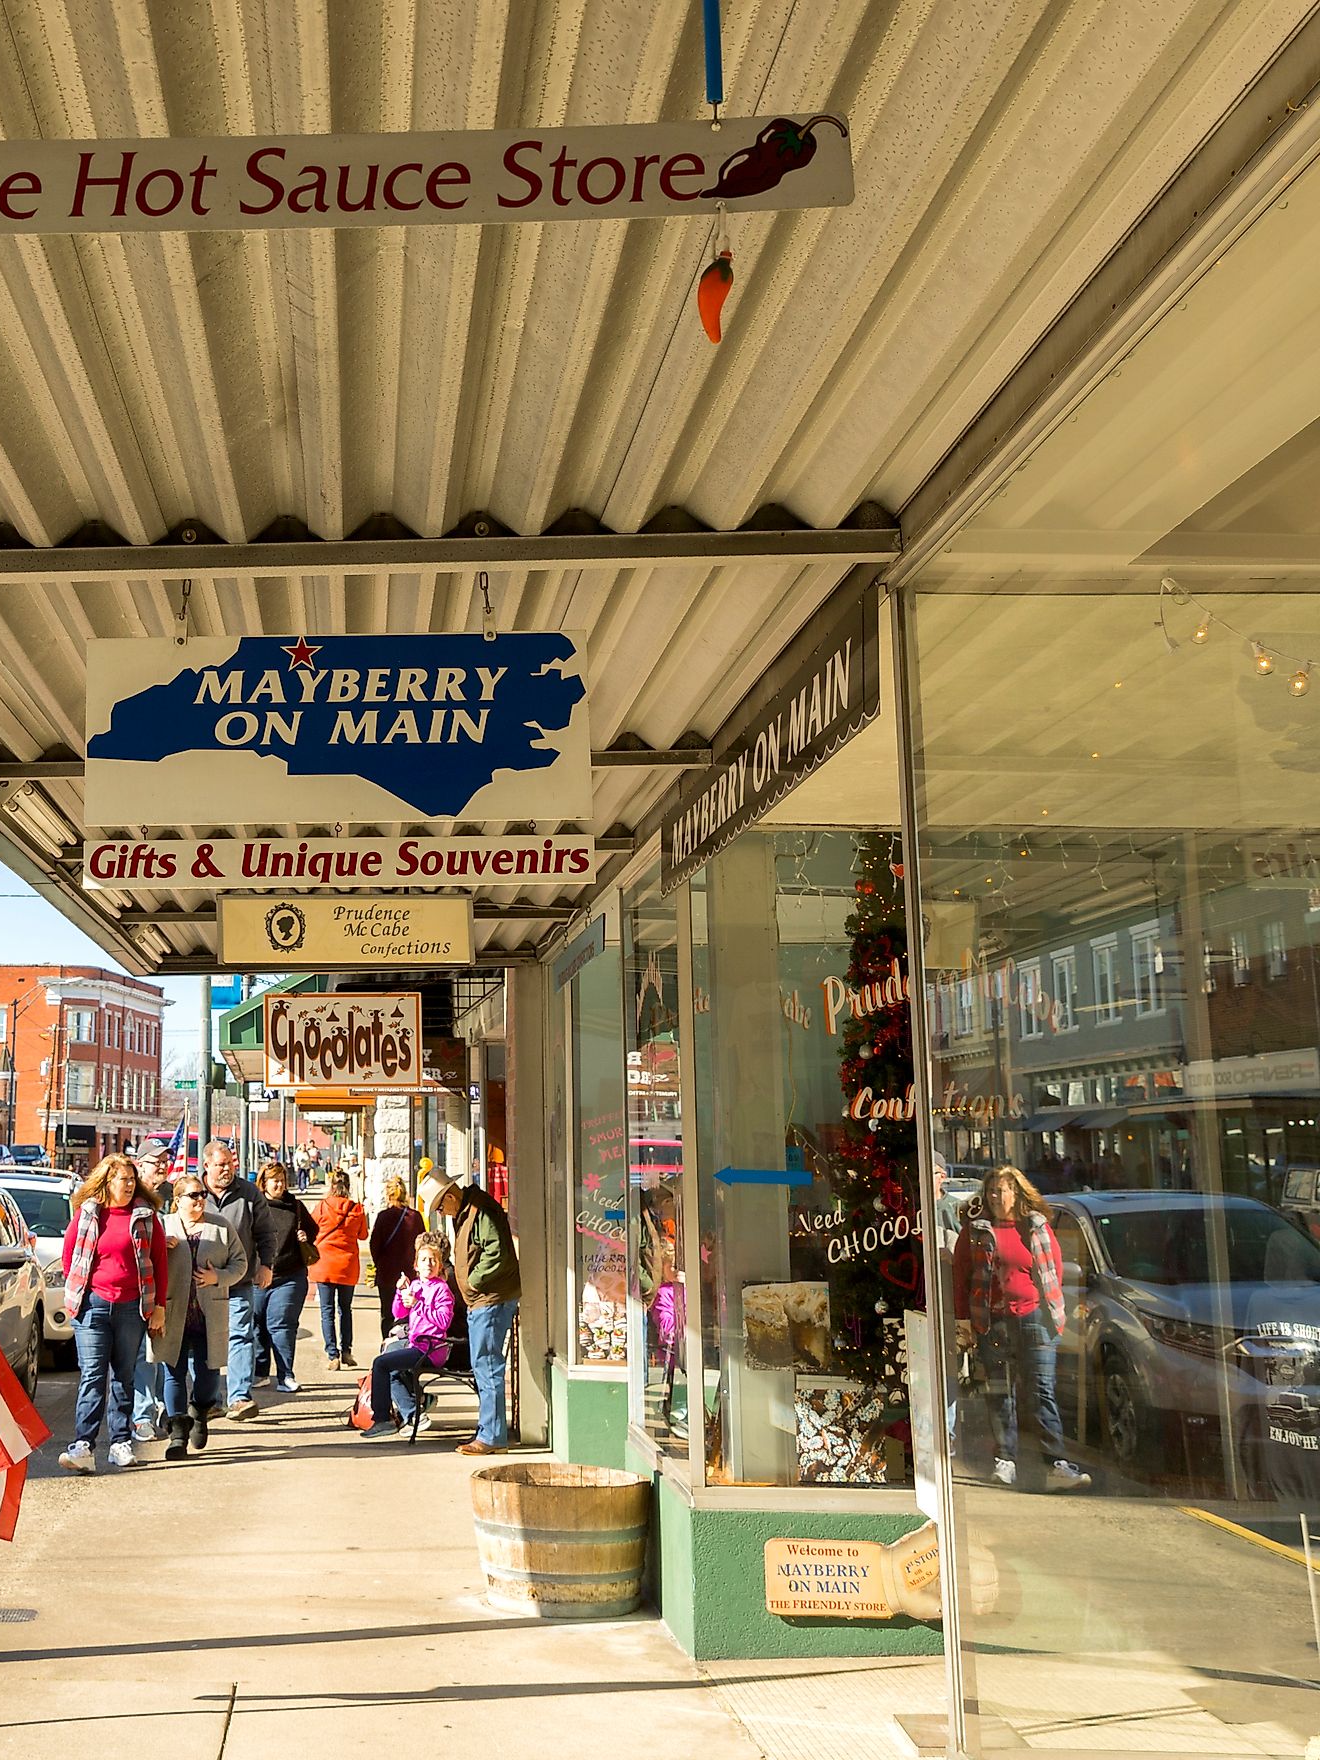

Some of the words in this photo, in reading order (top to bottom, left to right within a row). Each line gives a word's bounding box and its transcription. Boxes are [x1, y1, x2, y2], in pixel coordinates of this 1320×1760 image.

[69, 153, 219, 219] Hot
[239, 147, 471, 215] Sauce
[495, 141, 706, 209] Store
[193, 667, 508, 704] MAYBERRY
[214, 710, 303, 746] ON
[328, 709, 490, 744] MAIN
[671, 748, 750, 870] MAYBERRY
[752, 713, 783, 792] ON
[786, 637, 852, 764] MAIN
[89, 843, 177, 879] Gifts
[191, 843, 226, 878] &
[241, 843, 382, 884] Unique
[396, 839, 590, 876] Souvenirs
[332, 905, 411, 922] Prudence
[360, 939, 451, 955] Confections
[271, 1000, 413, 1082] Chocolates
[1257, 1321, 1279, 1338] LIFE
[1279, 1321, 1292, 1337] IS
[787, 1544, 843, 1557] Welcome
[847, 1547, 859, 1557] to
[777, 1564, 870, 1578] MAYBERRY
[788, 1580, 811, 1593] ON
[816, 1581, 860, 1594] MAIN
[769, 1600, 791, 1609] THE
[793, 1599, 852, 1611] FRIENDLY
[854, 1602, 887, 1612] STORE
